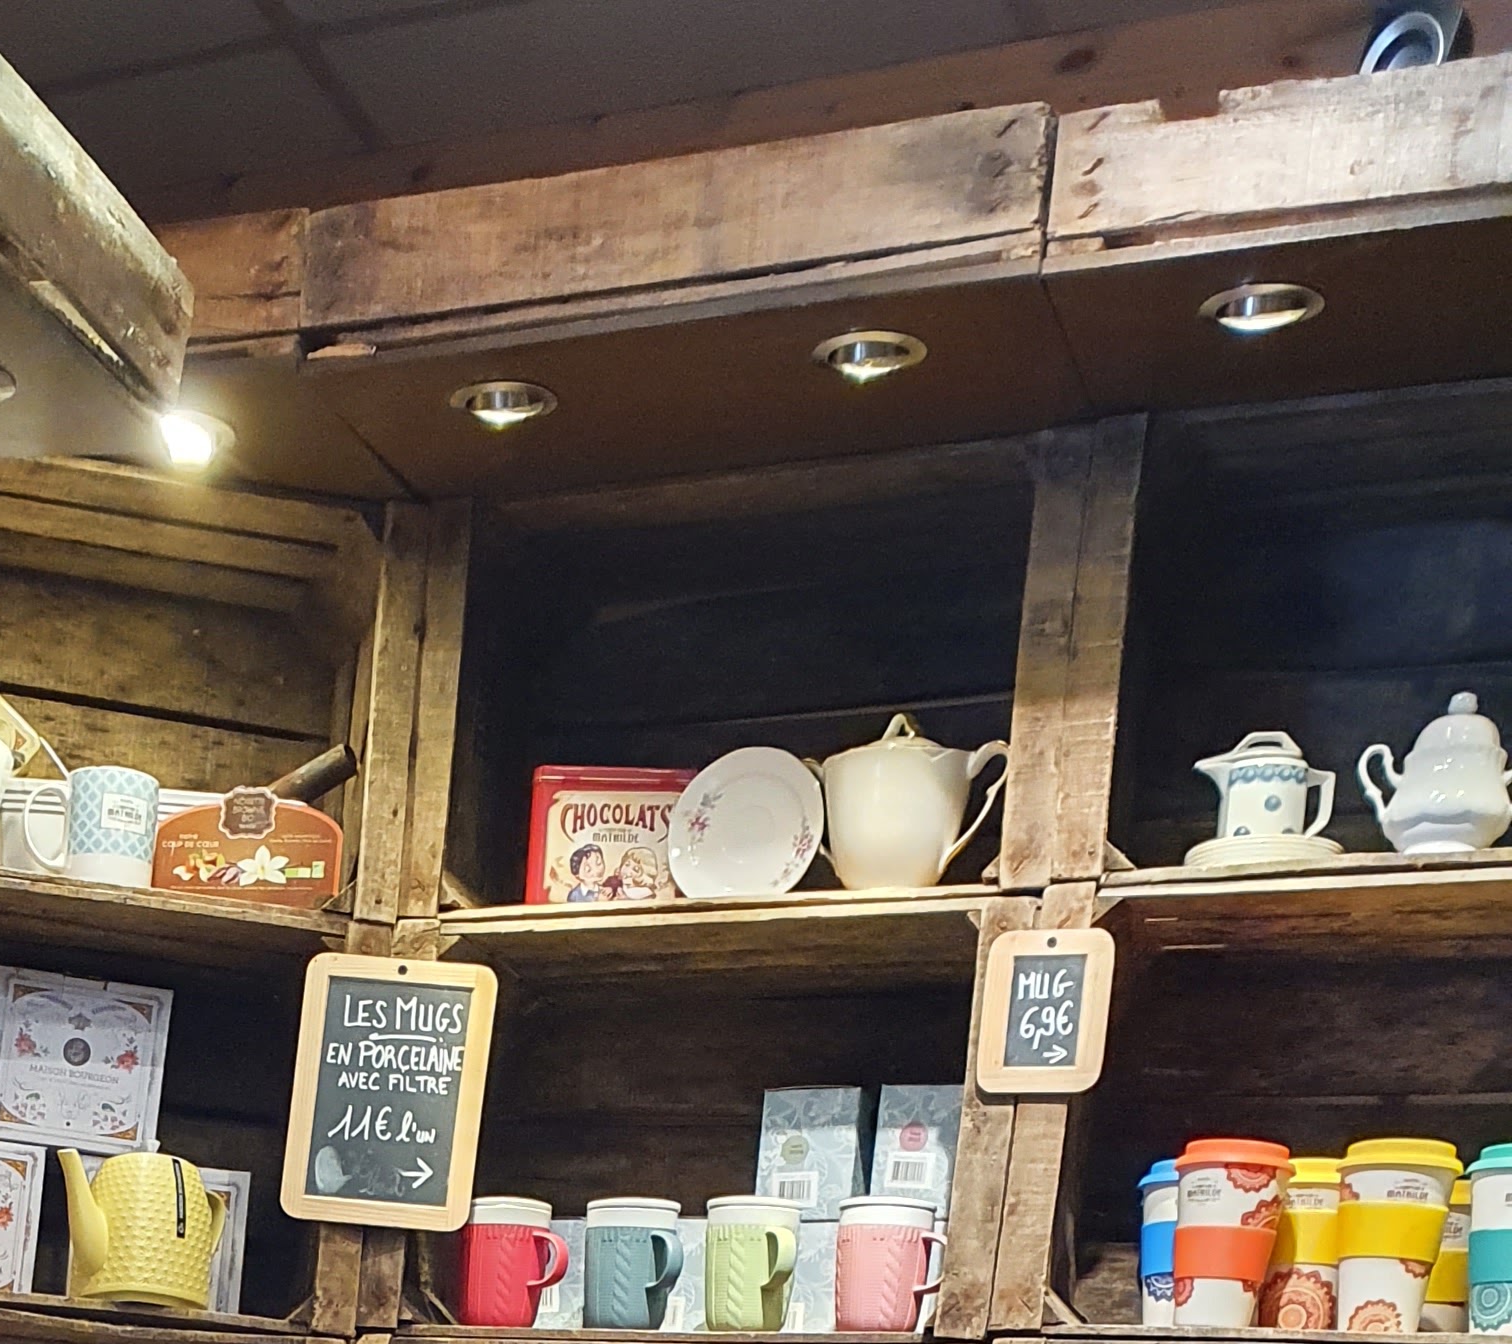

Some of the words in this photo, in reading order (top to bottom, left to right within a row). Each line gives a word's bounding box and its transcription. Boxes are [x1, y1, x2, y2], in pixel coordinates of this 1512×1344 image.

[560, 803, 674, 843] CHOCOLATS
[1017, 968, 1074, 1000] MUG
[343, 995, 387, 1028] LES
[395, 996, 464, 1034] MUGS
[326, 1042, 352, 1066] EN
[338, 1071, 380, 1090] AVEC
[389, 1073, 452, 1095] FILTRE
[327, 1104, 392, 1141] 11€
